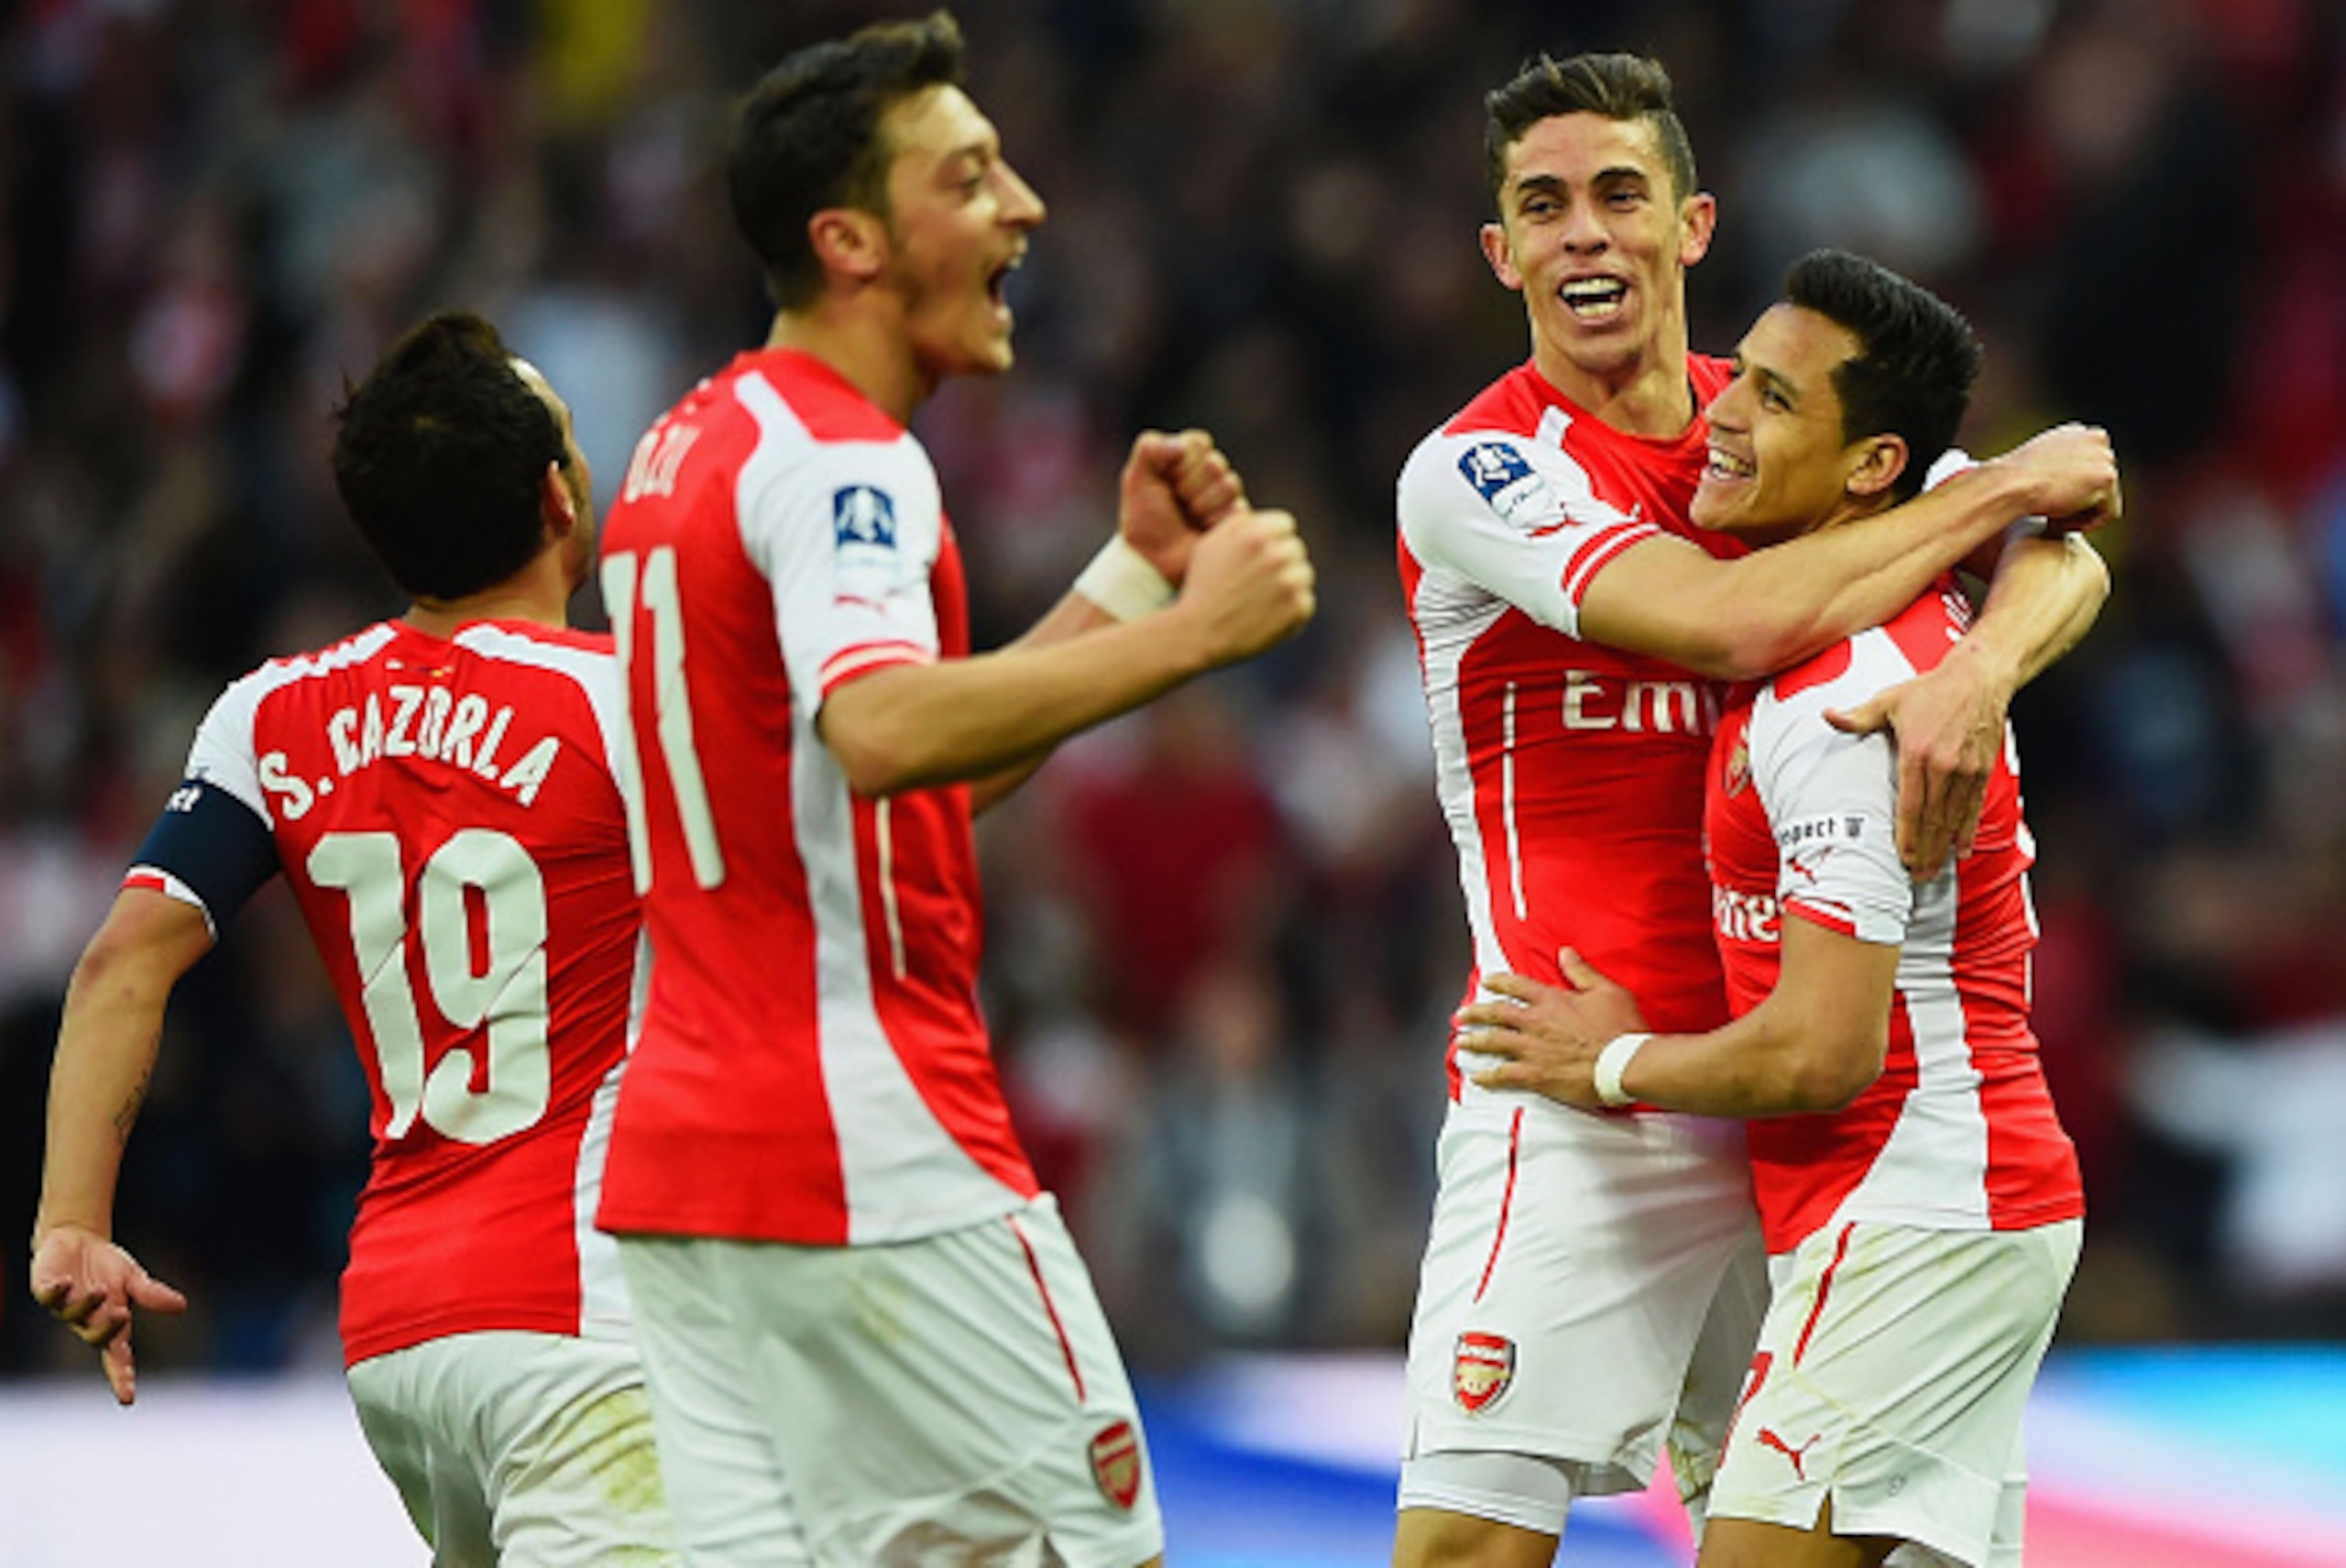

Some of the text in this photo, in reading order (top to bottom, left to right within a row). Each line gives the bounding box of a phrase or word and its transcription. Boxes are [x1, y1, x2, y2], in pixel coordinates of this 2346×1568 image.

[259, 684, 561, 822] S. CAZORLA
[599, 545, 726, 897] 11
[307, 828, 551, 1145] 19
